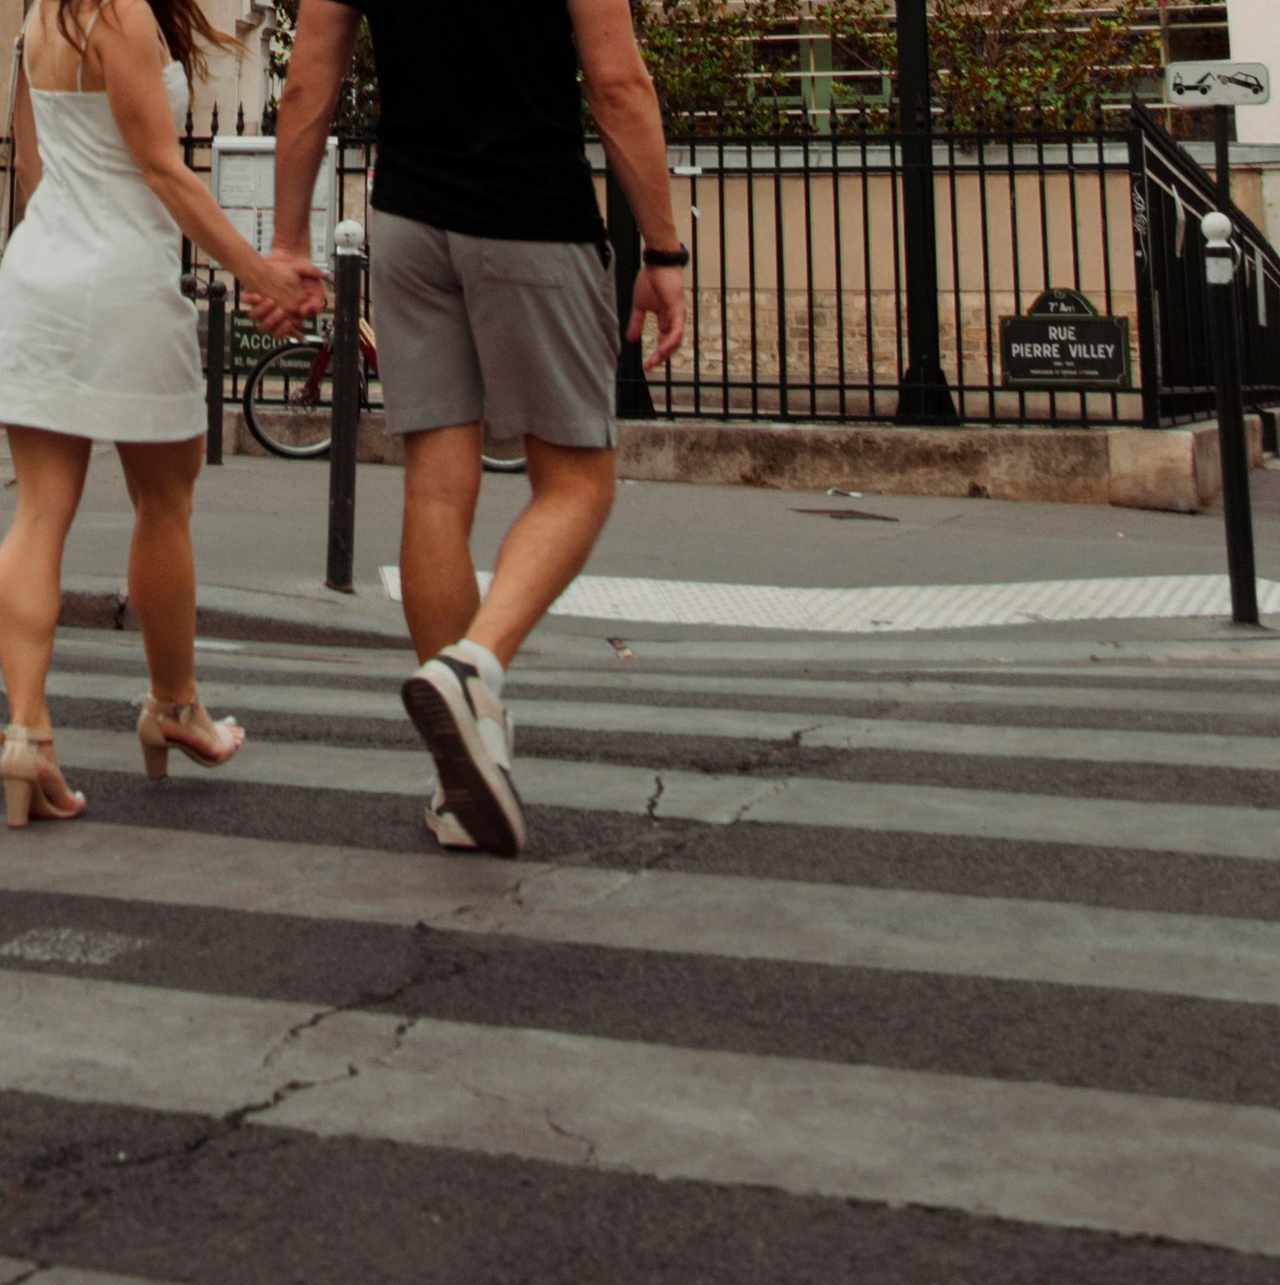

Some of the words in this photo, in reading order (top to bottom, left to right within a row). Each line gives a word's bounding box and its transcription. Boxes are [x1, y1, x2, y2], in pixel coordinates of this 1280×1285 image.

[1048, 325, 1076, 340] RUE
[1011, 343, 1061, 358] PIERRE
[1068, 344, 1115, 358] VILLEY
